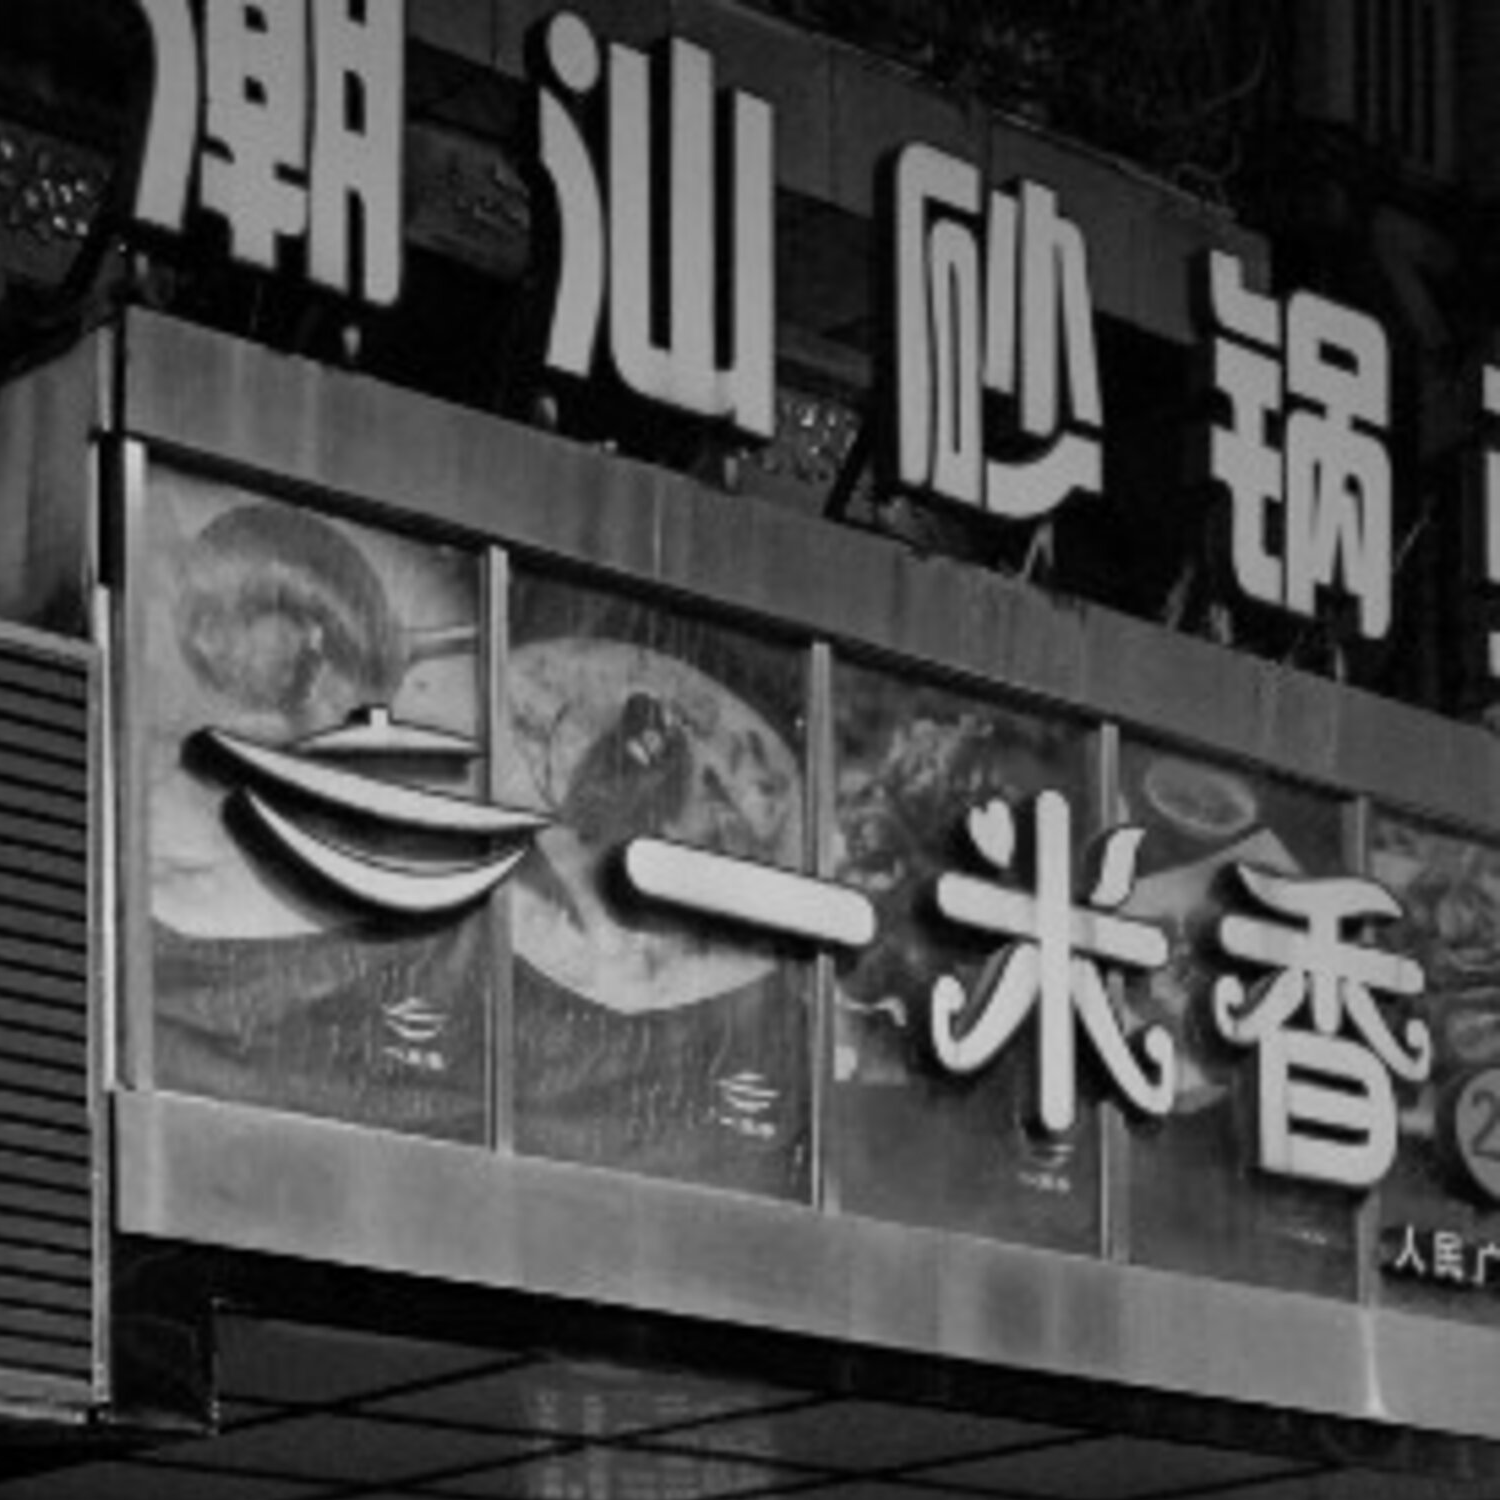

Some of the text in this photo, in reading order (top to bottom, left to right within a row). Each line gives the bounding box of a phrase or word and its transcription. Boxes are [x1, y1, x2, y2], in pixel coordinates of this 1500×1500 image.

[134, 0, 1500, 680] 潮汕砂锅
[623, 789, 1433, 1188] 一米香
